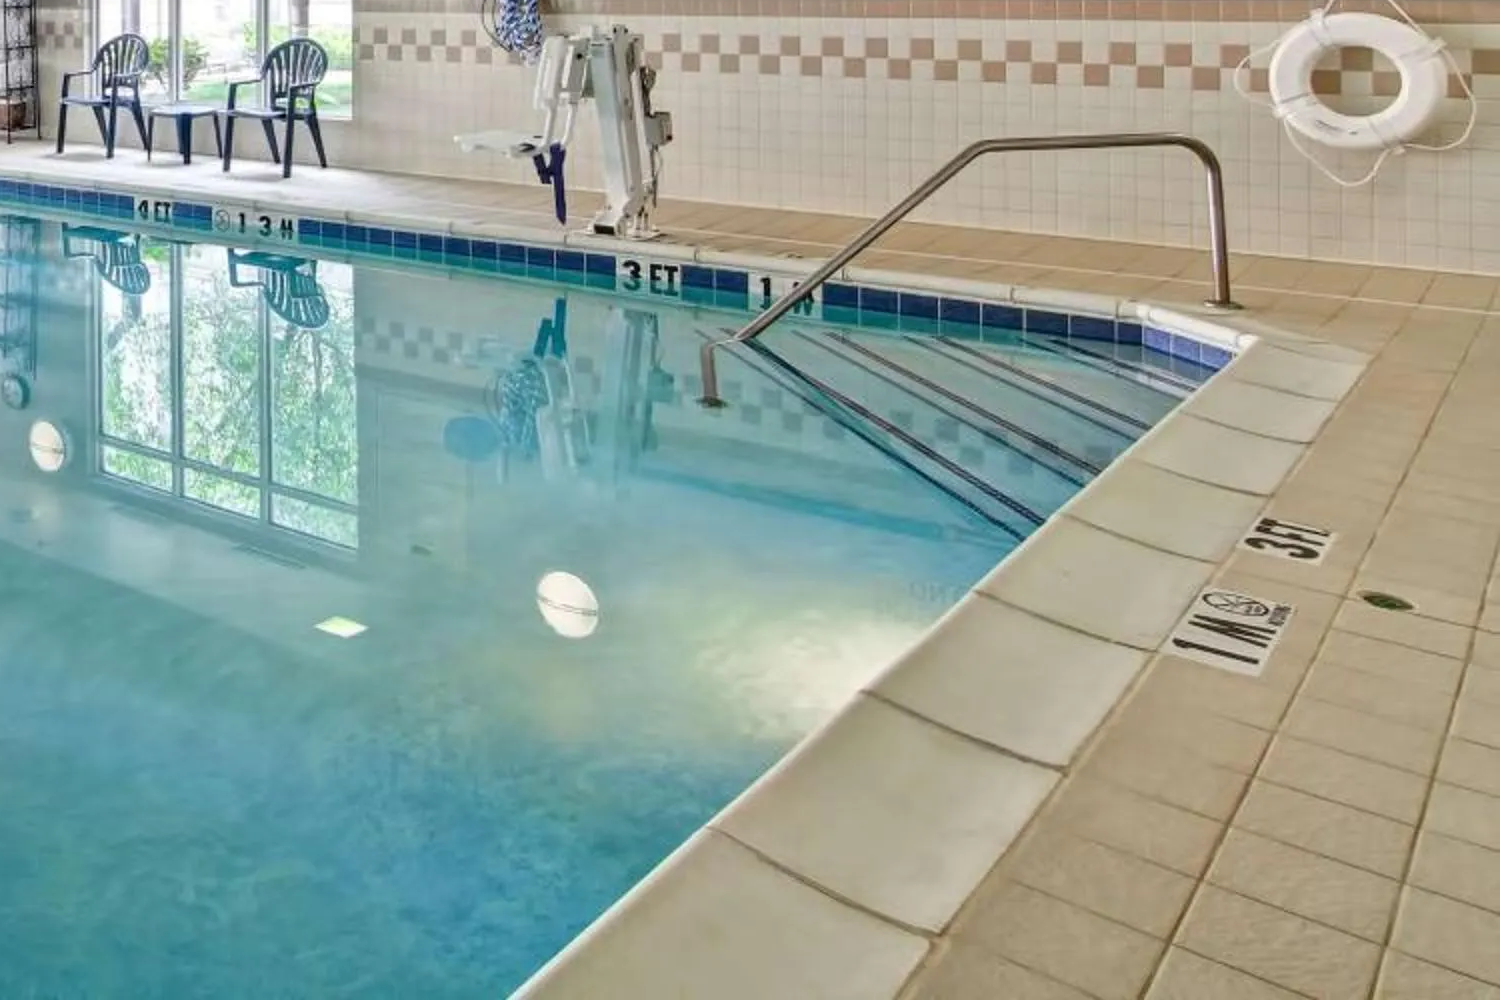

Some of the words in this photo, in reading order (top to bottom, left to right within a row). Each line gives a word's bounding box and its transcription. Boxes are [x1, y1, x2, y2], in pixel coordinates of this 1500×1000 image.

[649, 263, 679, 294] FT
[1254, 517, 1331, 547] FT
[1244, 537, 1320, 560] 3
[1188, 613, 1277, 648] M
[1172, 637, 1260, 665] 1
